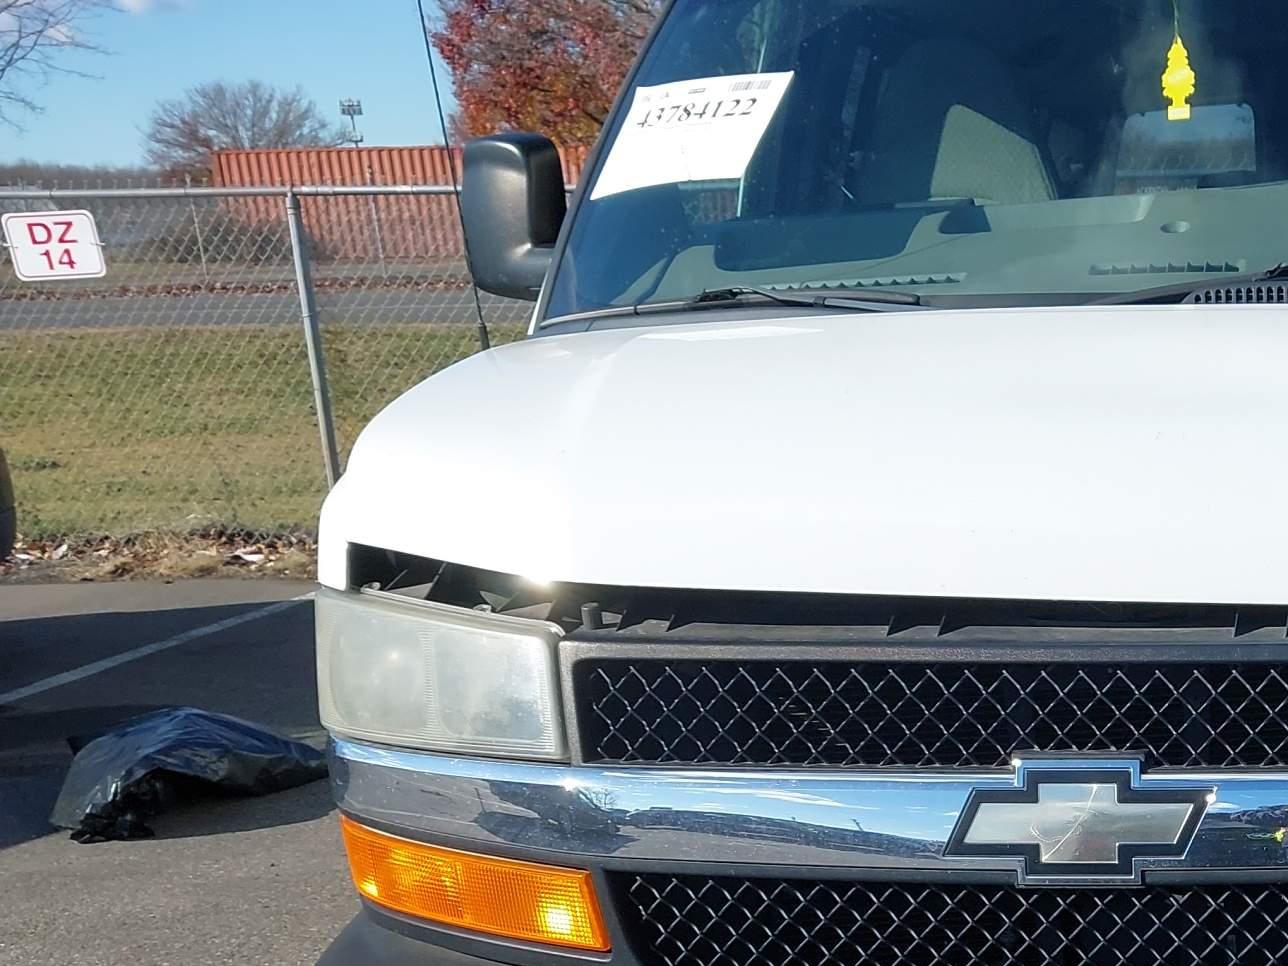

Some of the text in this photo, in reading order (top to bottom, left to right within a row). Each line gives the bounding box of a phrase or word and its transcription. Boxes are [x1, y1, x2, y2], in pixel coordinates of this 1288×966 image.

[636, 97, 758, 128] 43784122
[26, 221, 78, 245] DZ
[40, 248, 77, 271] 14
